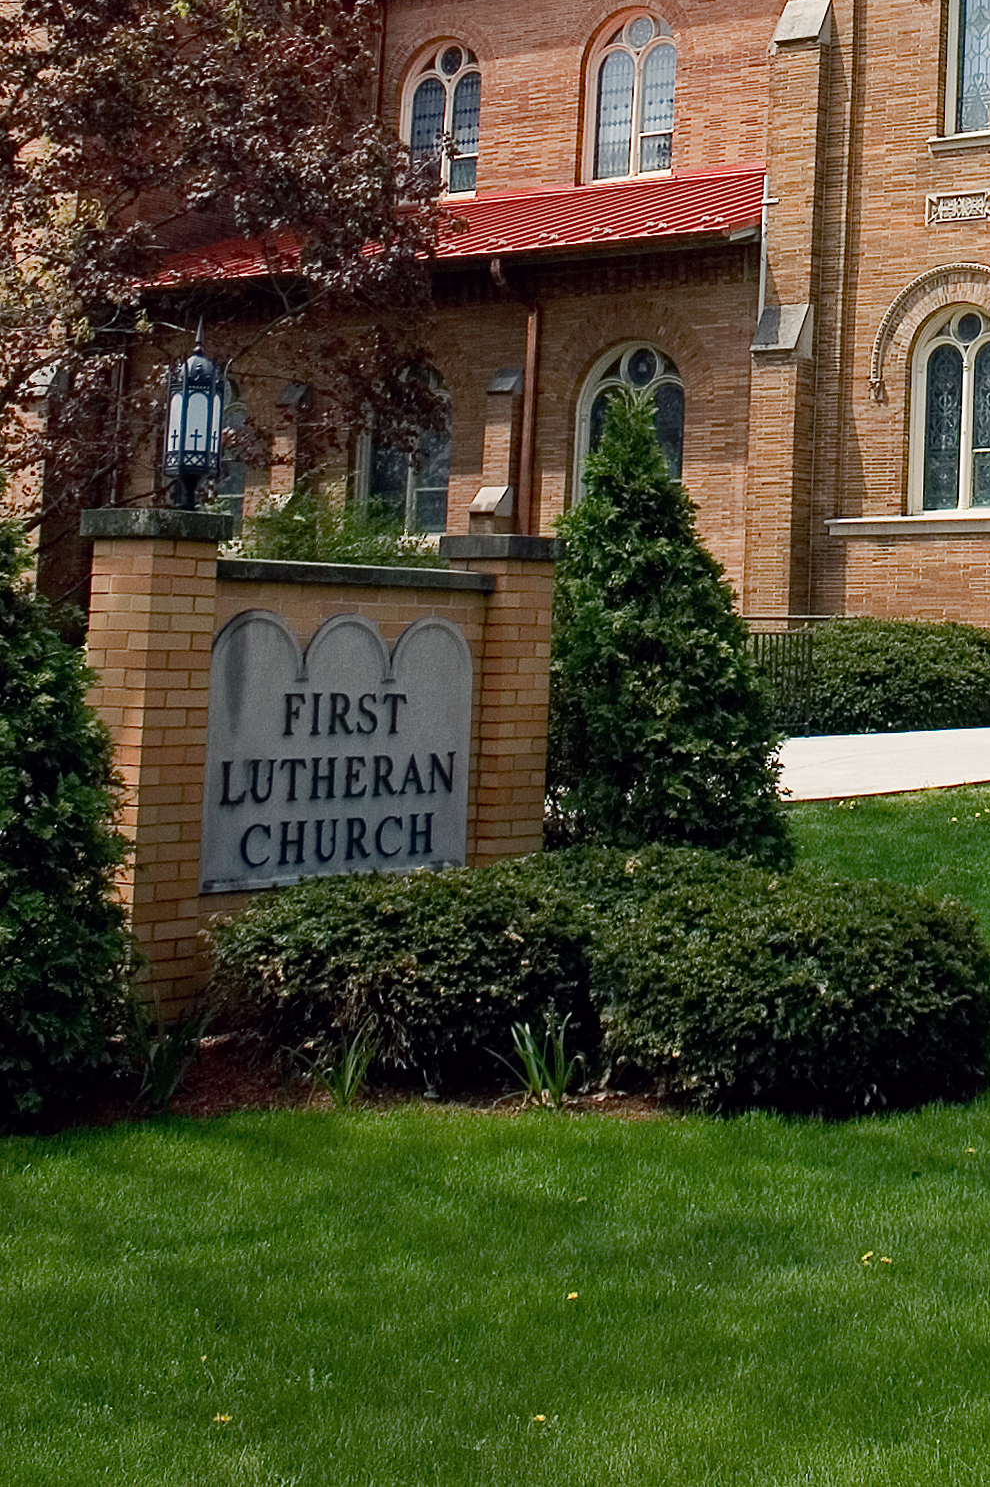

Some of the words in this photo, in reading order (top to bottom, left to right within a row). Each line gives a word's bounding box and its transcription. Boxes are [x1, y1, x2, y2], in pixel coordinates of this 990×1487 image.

[282, 691, 408, 737] FIRST
[218, 750, 457, 806] LUTHERAN
[239, 811, 436, 868] CHURCH
